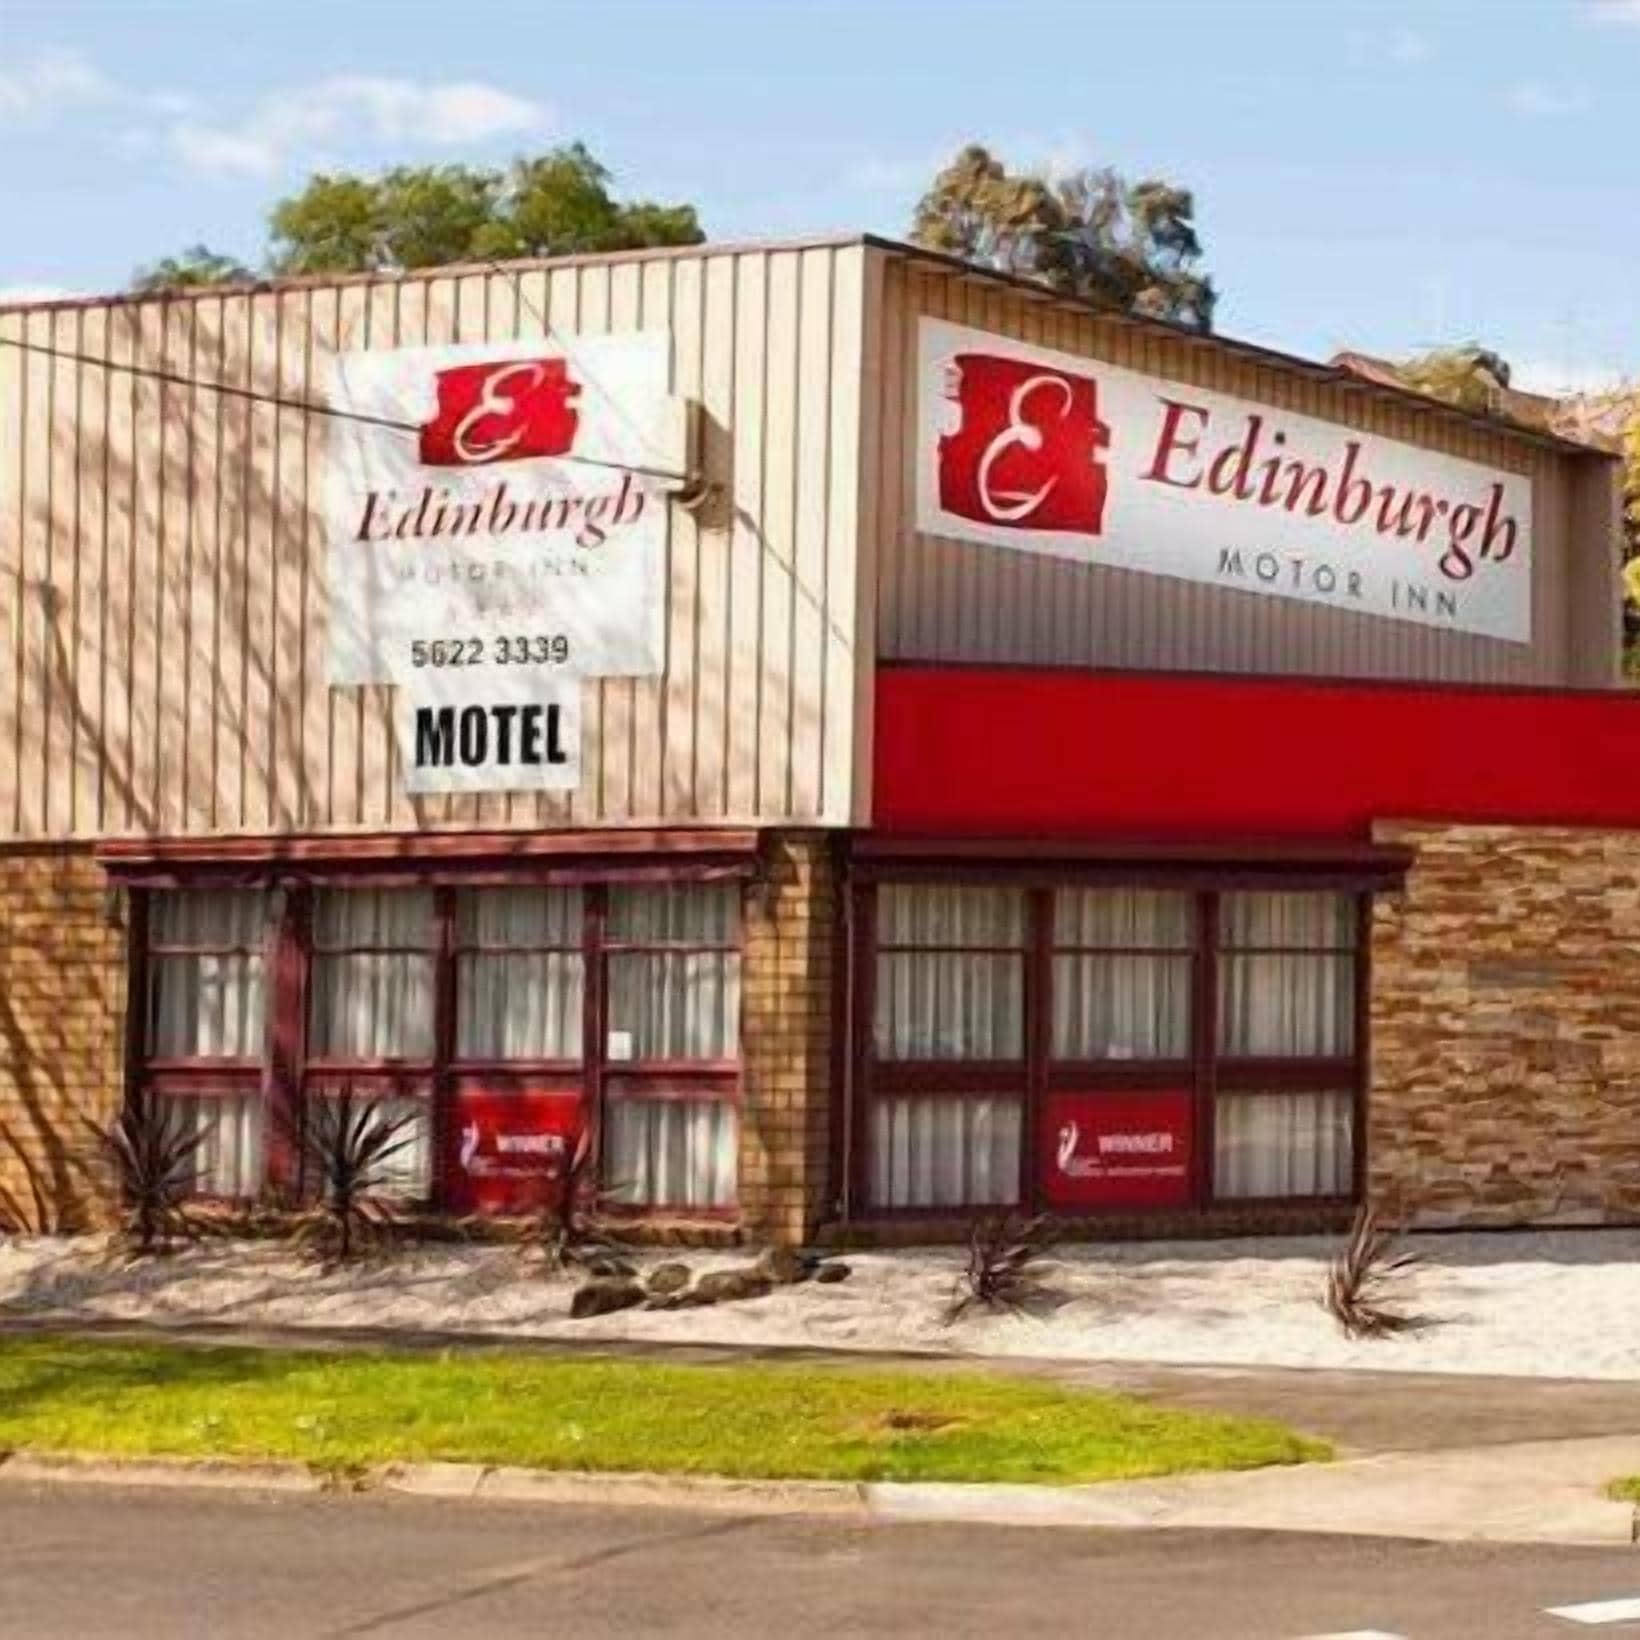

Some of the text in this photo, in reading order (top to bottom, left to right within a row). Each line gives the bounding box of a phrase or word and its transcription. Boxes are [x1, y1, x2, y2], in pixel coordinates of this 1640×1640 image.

[356, 474, 646, 549] Edinburgh
[1136, 394, 1518, 581] Edinburgh
[1214, 547, 1459, 618] MOTOR INN
[411, 634, 570, 668] 5622 3339
[414, 702, 568, 768] MOTEL
